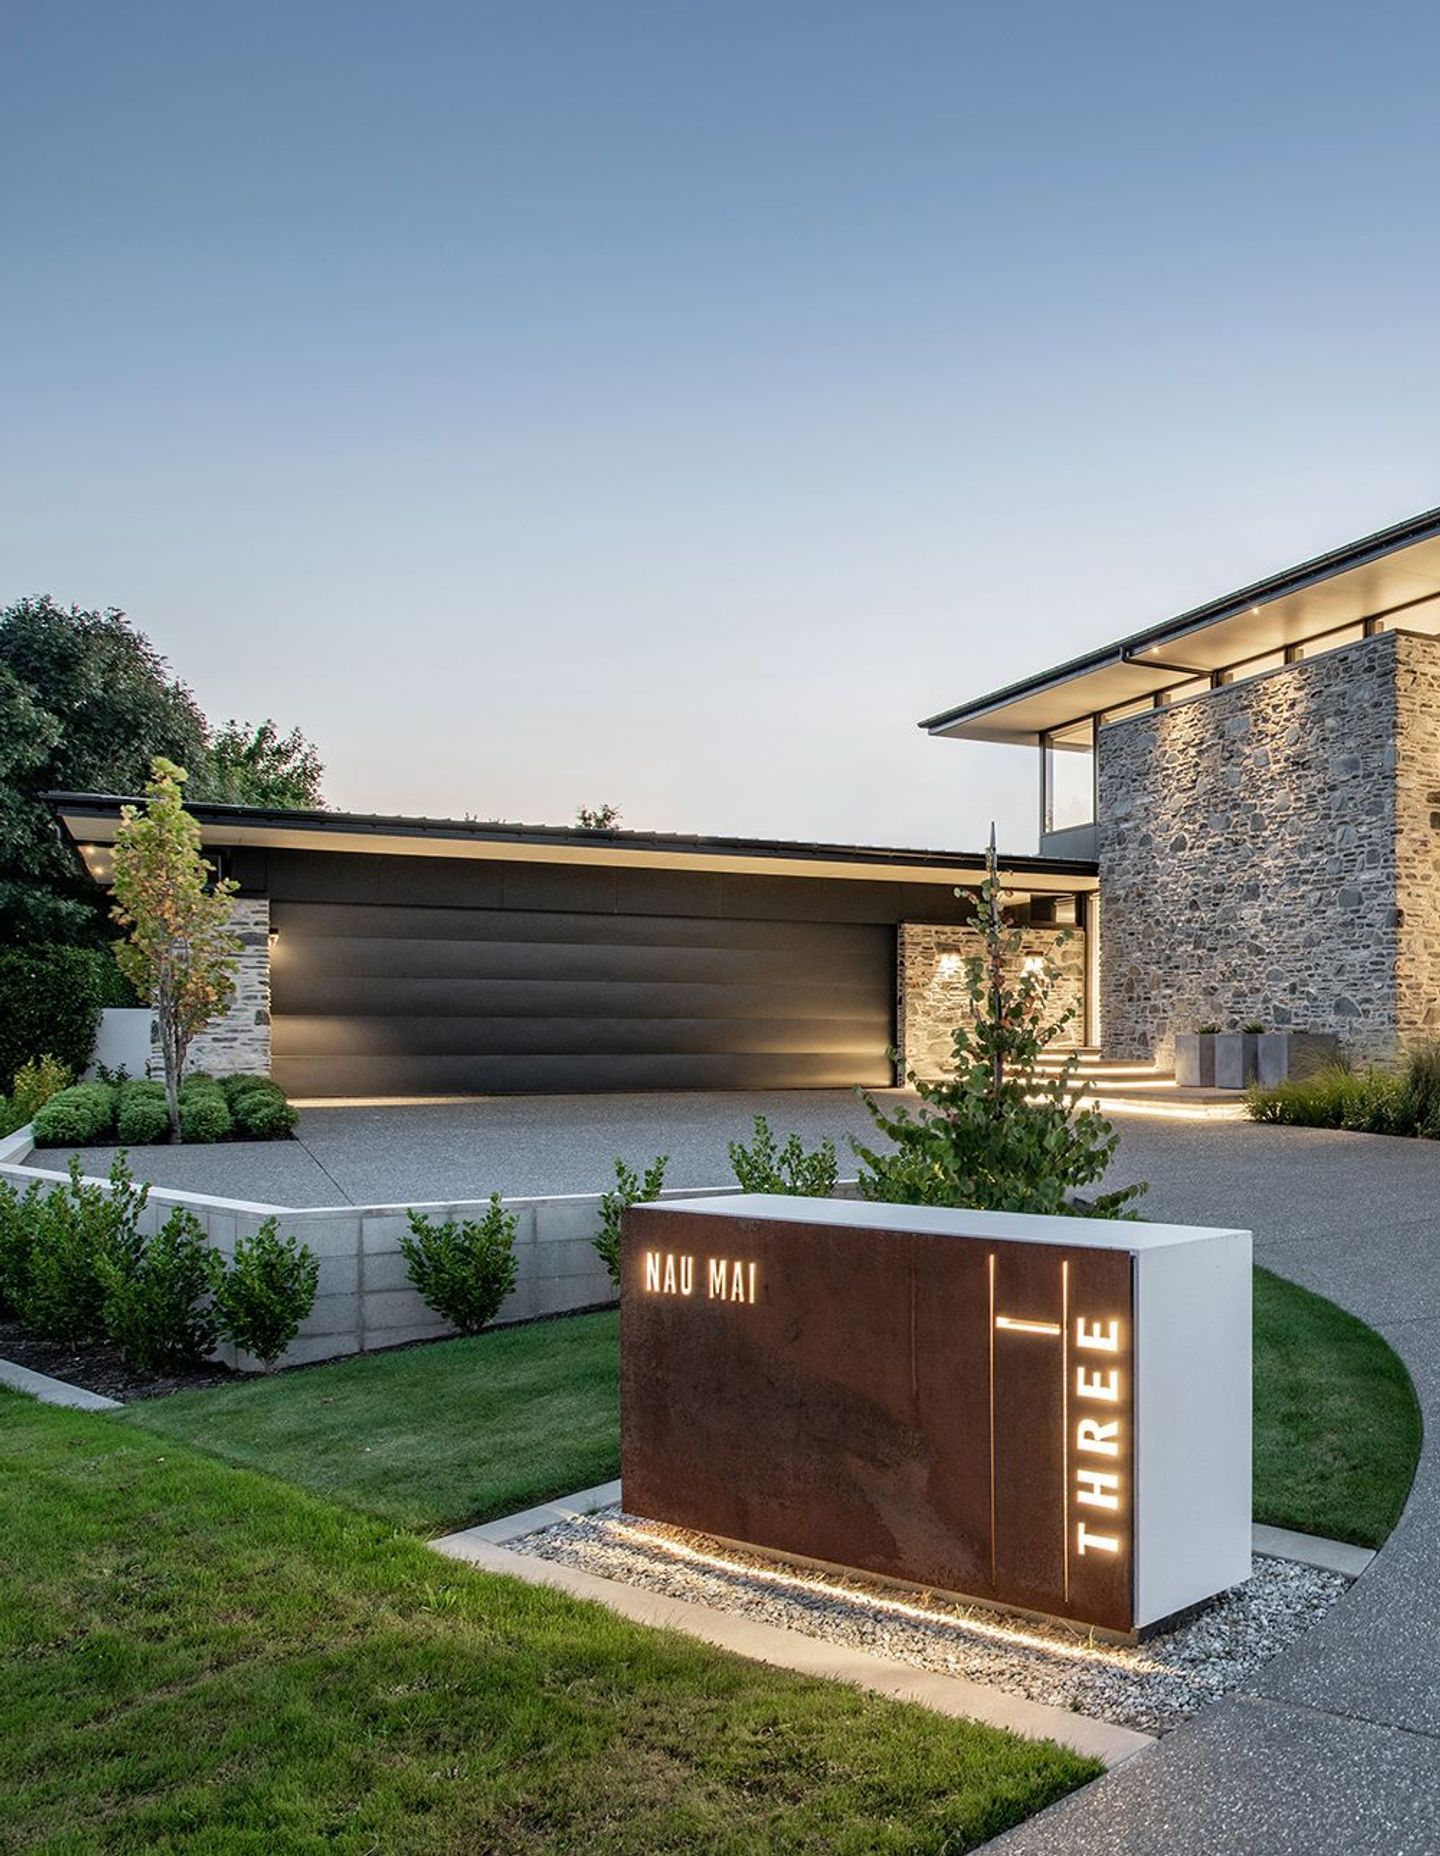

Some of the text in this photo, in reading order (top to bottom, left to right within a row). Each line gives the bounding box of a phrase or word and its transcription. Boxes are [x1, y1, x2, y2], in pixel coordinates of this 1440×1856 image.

[644, 1251, 757, 1304] NAU MAI
[1075, 1316, 1121, 1556] THREE
